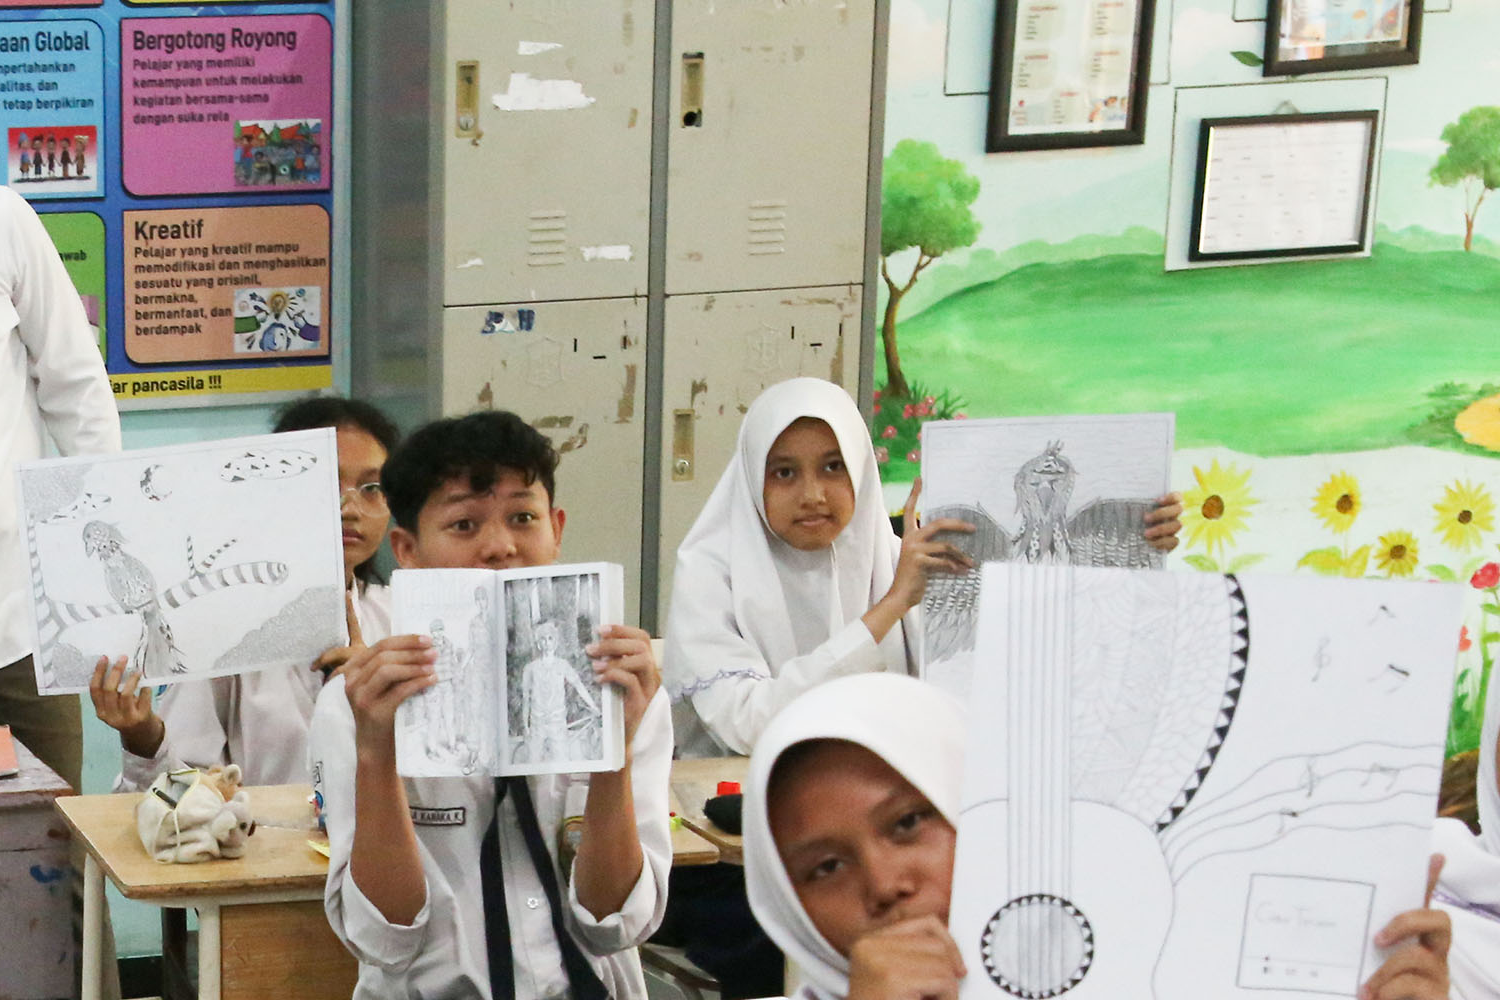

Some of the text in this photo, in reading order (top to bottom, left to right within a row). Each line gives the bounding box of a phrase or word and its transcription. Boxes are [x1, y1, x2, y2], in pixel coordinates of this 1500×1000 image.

[35, 31, 90, 51] Global
[133, 28, 297, 53] Bergotong Royong
[133, 56, 255, 72] Pelajar yang memiliki
[38, 79, 58, 91] dan
[133, 74, 303, 89] kemampuan untuk melakukan
[3, 98, 33, 112] tetap
[36, 97, 94, 111] berpikiran
[133, 93, 269, 108] kegiatan bersama-sama
[133, 110, 230, 126] dengan suka rela
[135, 219, 204, 241] Kreatif
[59, 249, 87, 262] wab
[134, 243, 300, 260] Pelajar yang kreatif mampu
[135, 256, 326, 273] memodifikasi dan menghasilkan
[135, 274, 261, 290] sesuatu yang orisinil,
[135, 293, 197, 305] bermakna,
[135, 306, 232, 321] bermanfaat, dan
[135, 323, 202, 336] berdampak
[132, 376, 204, 395] pancasila
[208, 375, 222, 389] !!!
